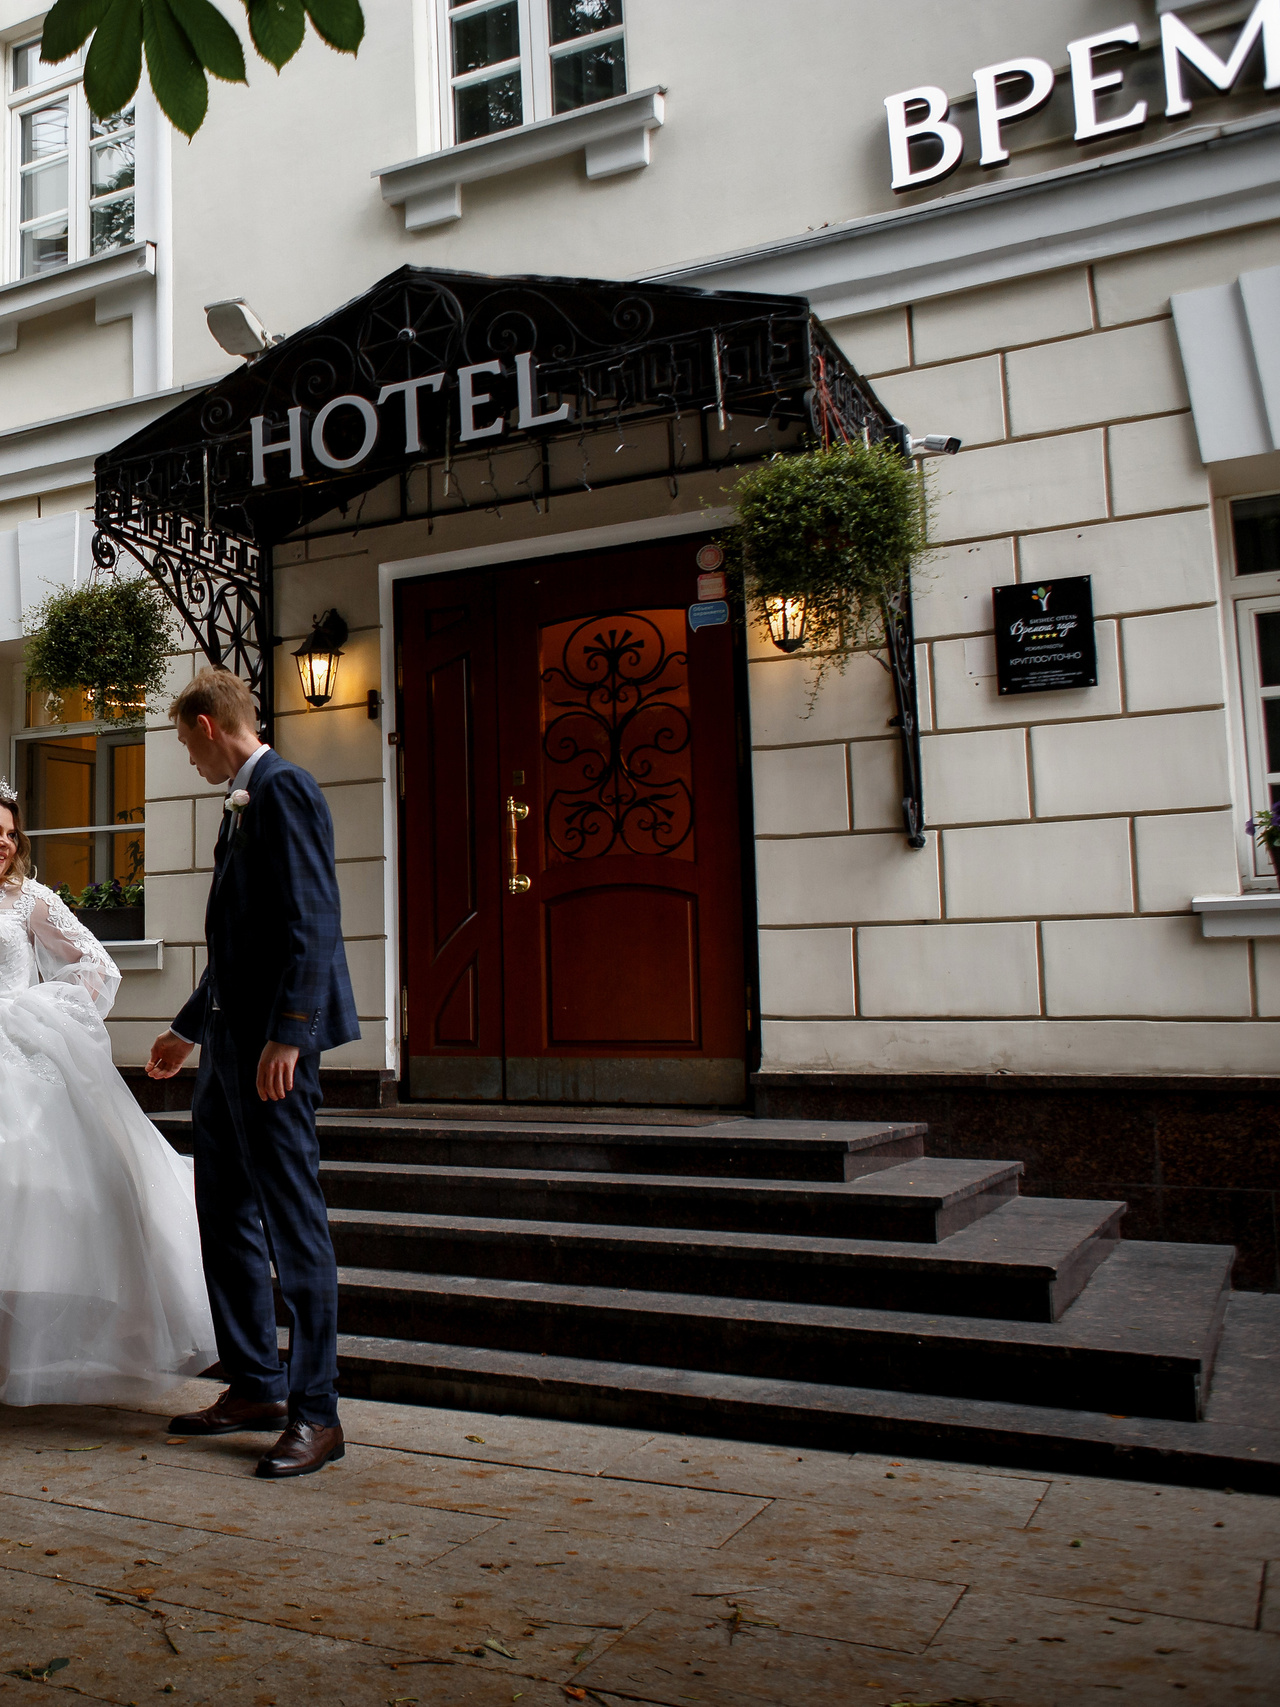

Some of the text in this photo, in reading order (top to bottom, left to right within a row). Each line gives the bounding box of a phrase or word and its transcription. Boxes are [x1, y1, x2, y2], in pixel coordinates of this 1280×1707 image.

[883, 0, 1280, 192] ВРЕМ
[250, 351, 570, 487] HOTEL
[1010, 618, 1077, 642] Времена года
[1010, 652, 1081, 665] КРУГЛОСУТОЧНО
